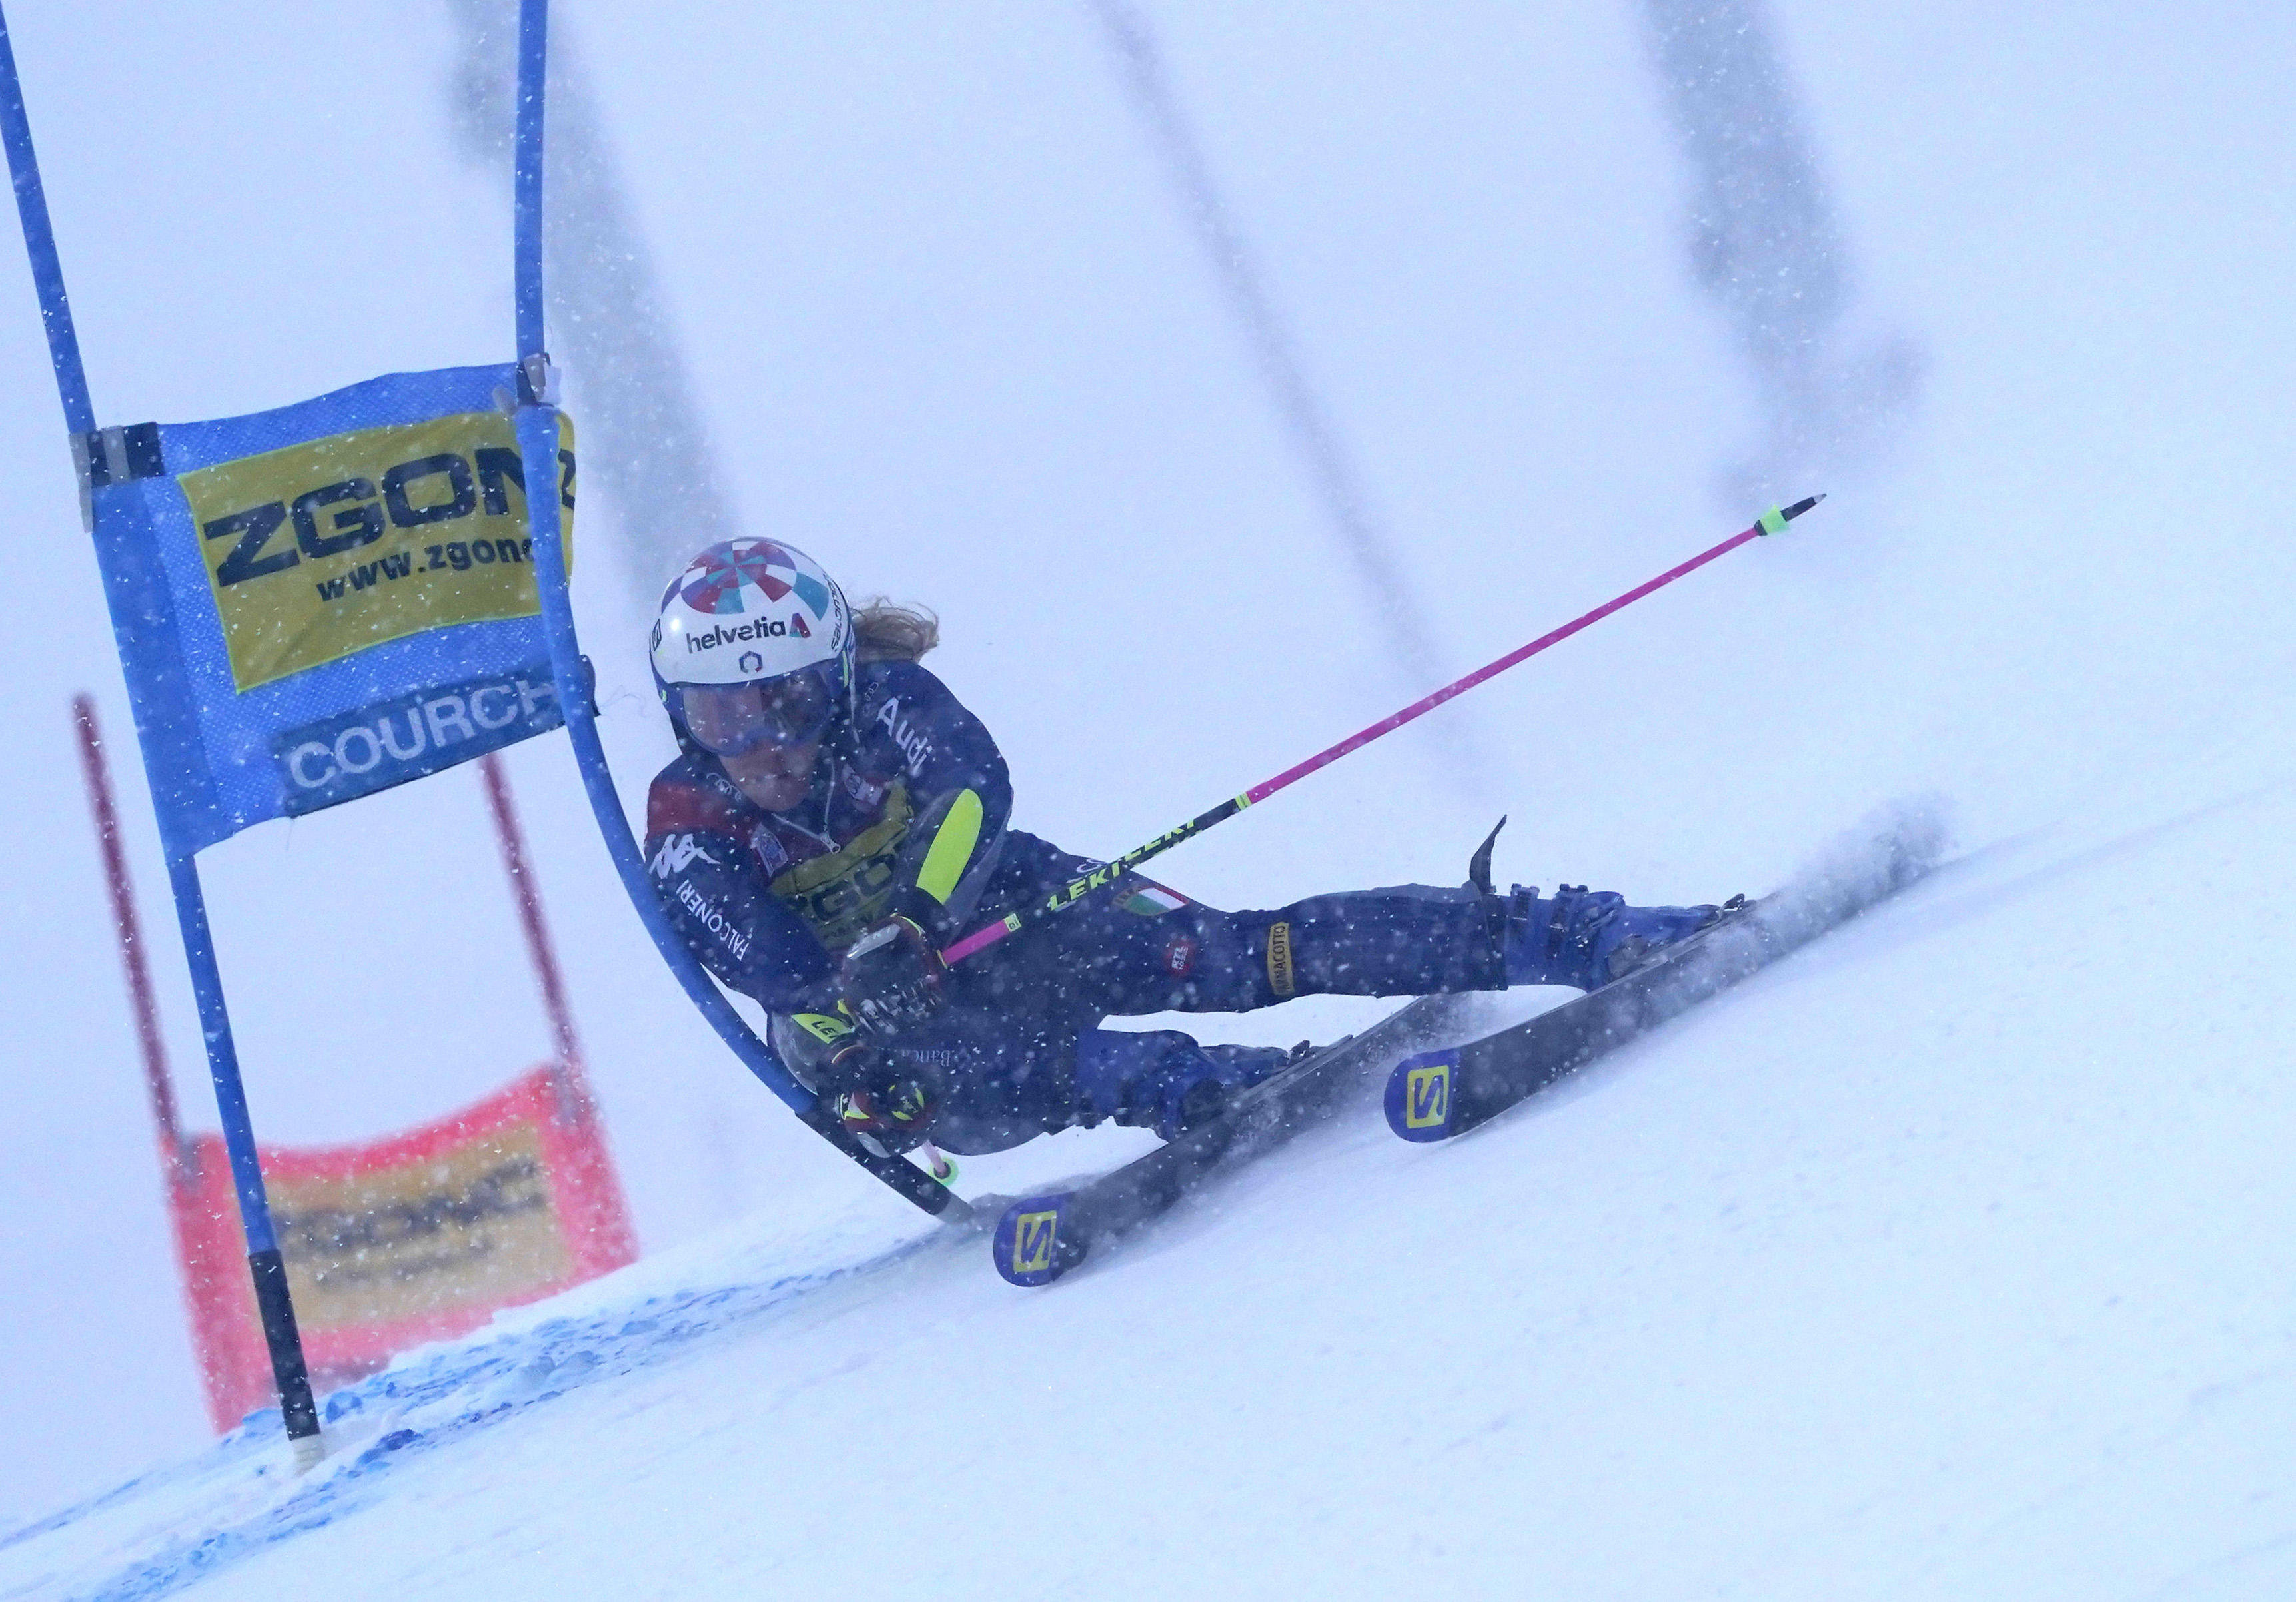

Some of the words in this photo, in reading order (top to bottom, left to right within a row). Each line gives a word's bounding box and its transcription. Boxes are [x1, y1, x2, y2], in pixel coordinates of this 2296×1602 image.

[203, 446, 576, 588] ZGON
[686, 616, 786, 654] helvetia
[875, 696, 933, 777] Audi
[676, 879, 750, 961] FALCONERI
[1049, 861, 1121, 911] LEKI
